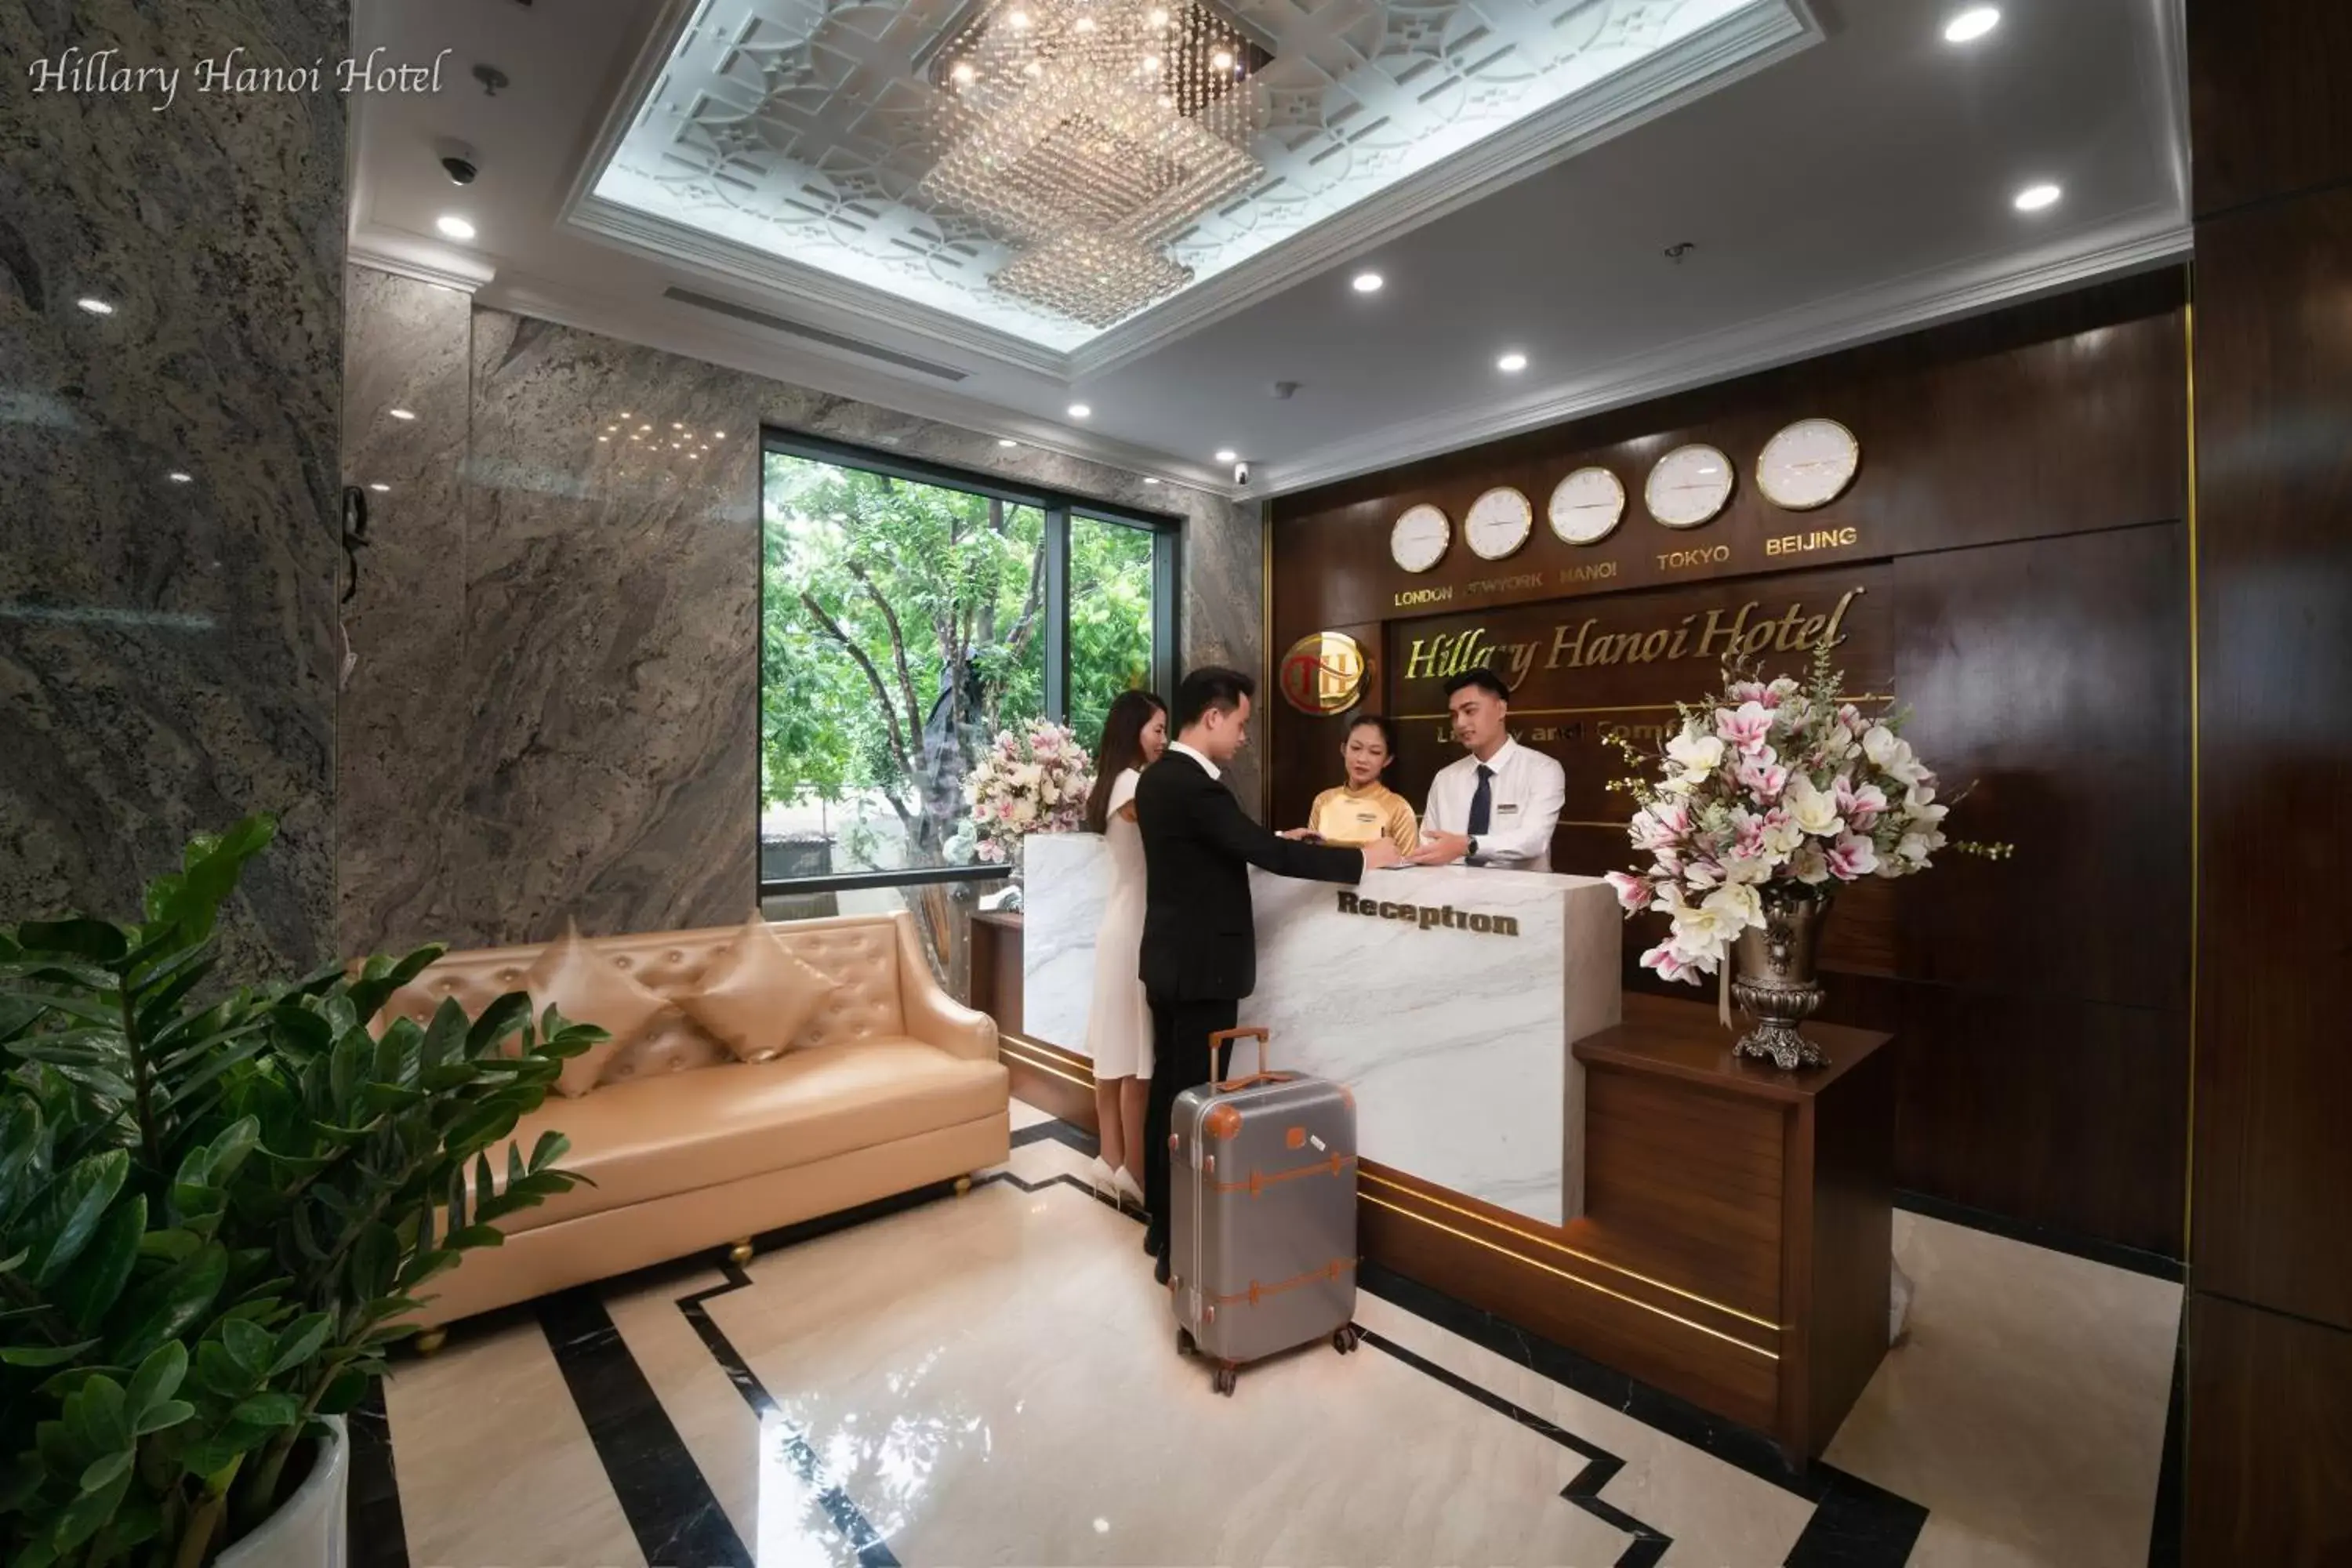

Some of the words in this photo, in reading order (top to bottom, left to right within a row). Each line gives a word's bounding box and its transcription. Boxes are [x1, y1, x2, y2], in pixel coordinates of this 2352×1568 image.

[1766, 527, 1857, 556] BEIJING
[1656, 545, 1730, 570] TOKYO
[1395, 586, 1453, 606] LONDON
[1404, 627, 1541, 692] Hillay
[1544, 614, 1697, 670] Hanoi
[1691, 586, 1865, 659] Hotel
[1337, 891, 1519, 936] Reception
